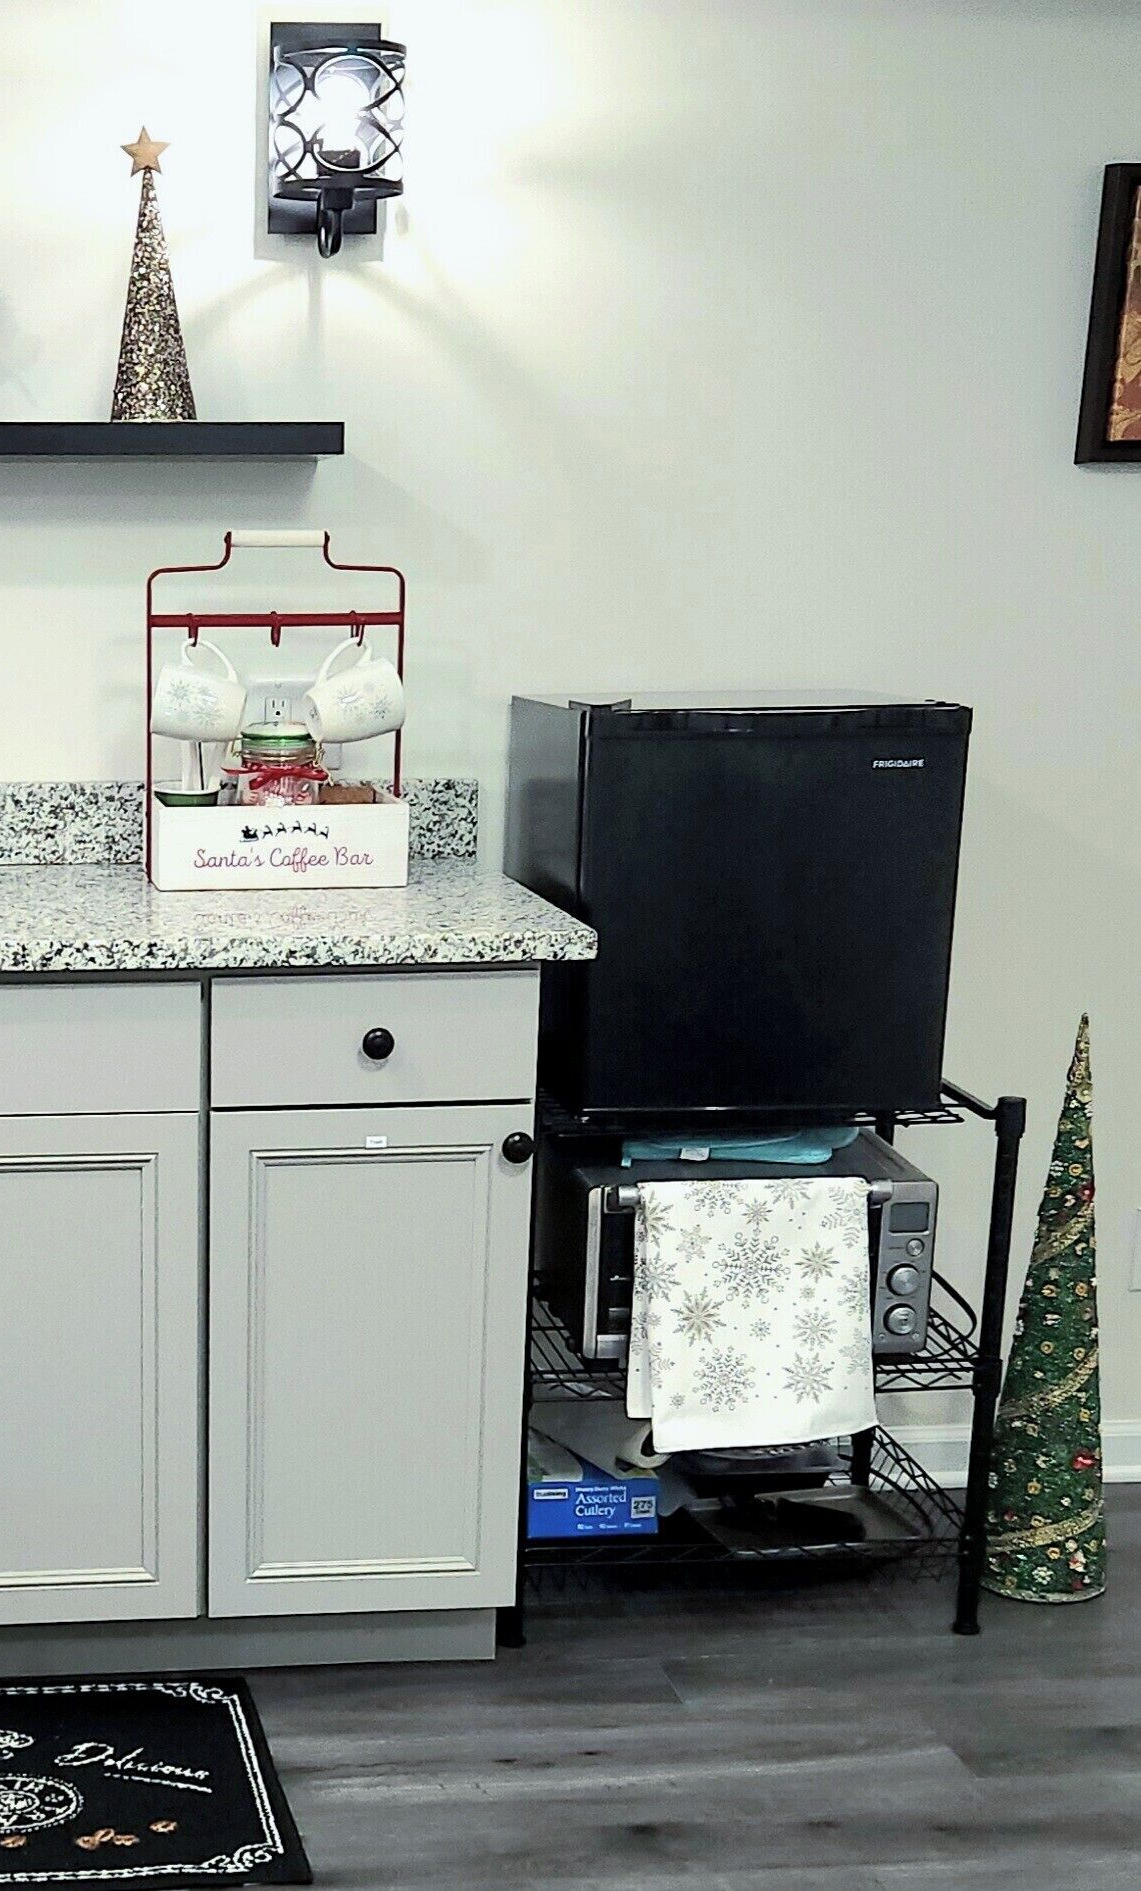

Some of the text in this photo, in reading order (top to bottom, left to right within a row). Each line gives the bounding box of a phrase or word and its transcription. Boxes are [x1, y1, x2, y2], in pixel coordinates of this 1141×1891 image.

[872, 758, 925, 769] FRIGIDAIRE
[193, 846, 374, 873] Santa's Coffee Bar
[575, 1491, 627, 1505] Assorted
[575, 1504, 616, 1519] Cutlery
